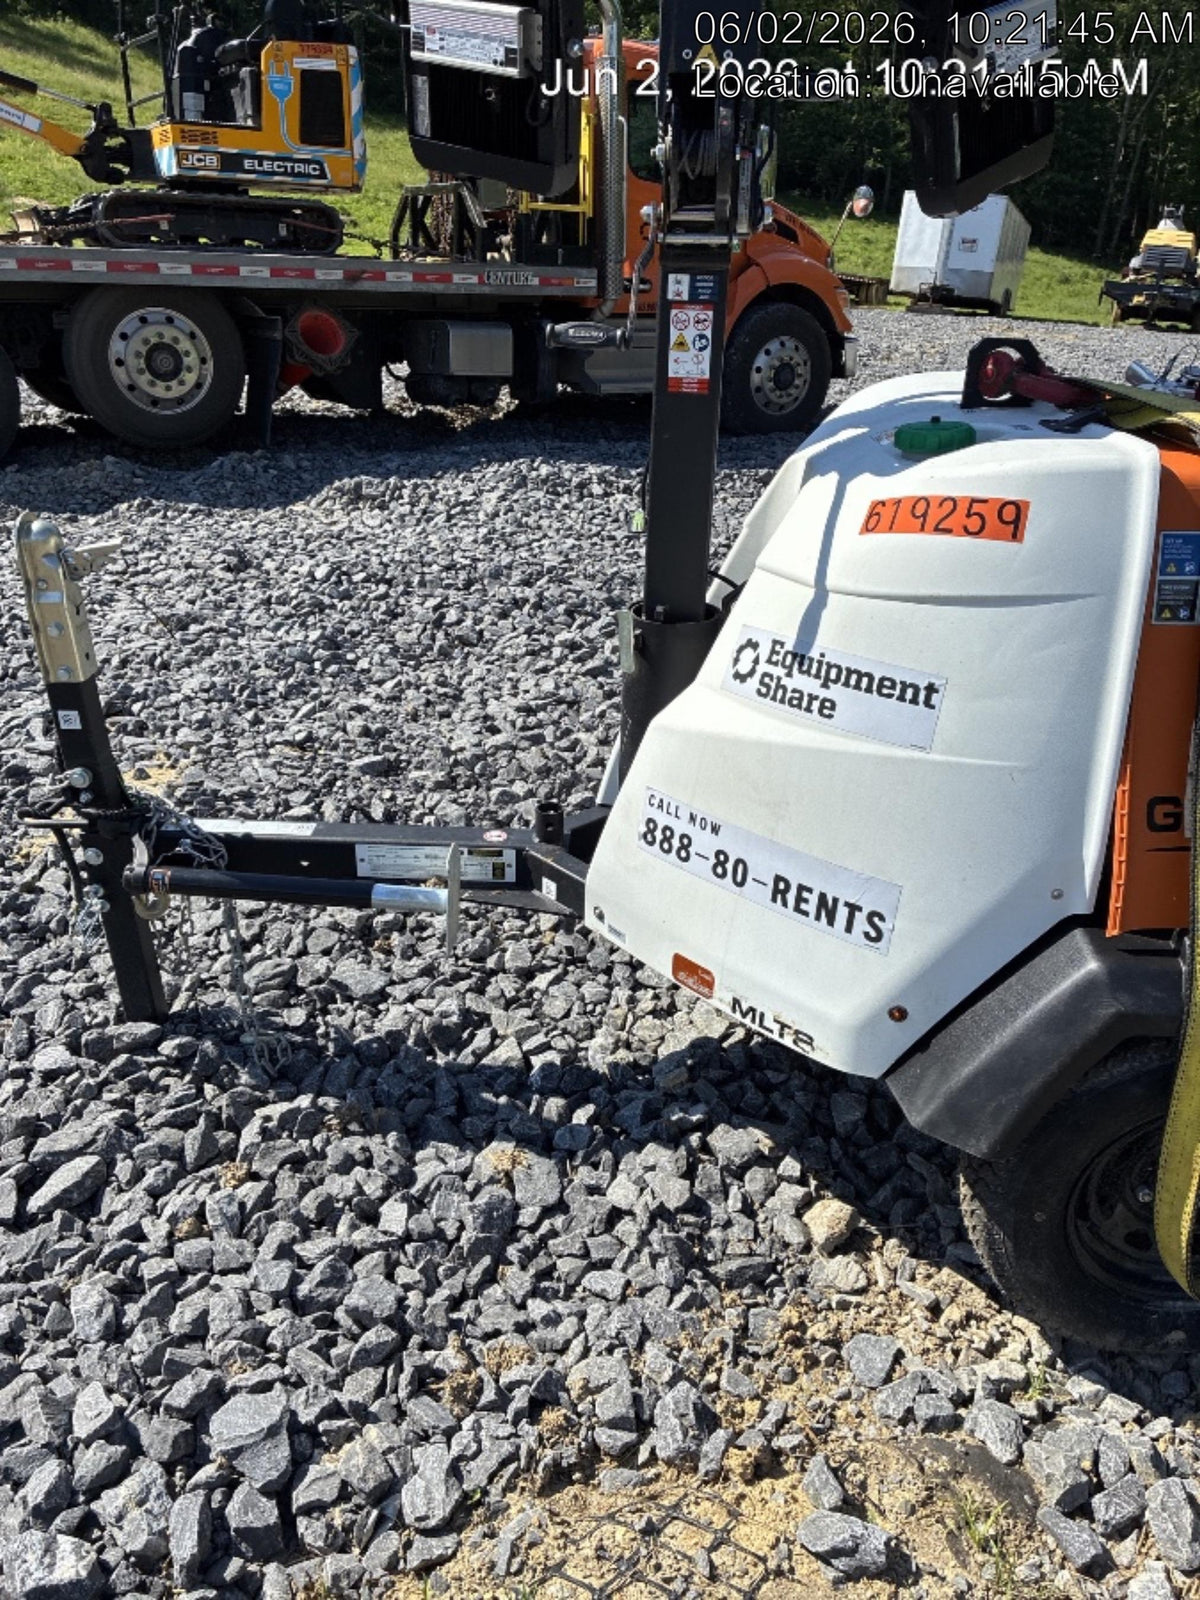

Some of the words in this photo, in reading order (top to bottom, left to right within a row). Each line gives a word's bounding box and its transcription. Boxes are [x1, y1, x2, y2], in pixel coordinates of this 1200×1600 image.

[181, 153, 218, 167] JCB
[243, 159, 321, 175] ELECTRIC
[864, 496, 1022, 540] 619259
[755, 671, 837, 721] Share
[765, 638, 940, 710] Equipment
[648, 793, 681, 820] CALL
[688, 811, 722, 837] NOW
[642, 817, 887, 944] 888-80-RENTS
